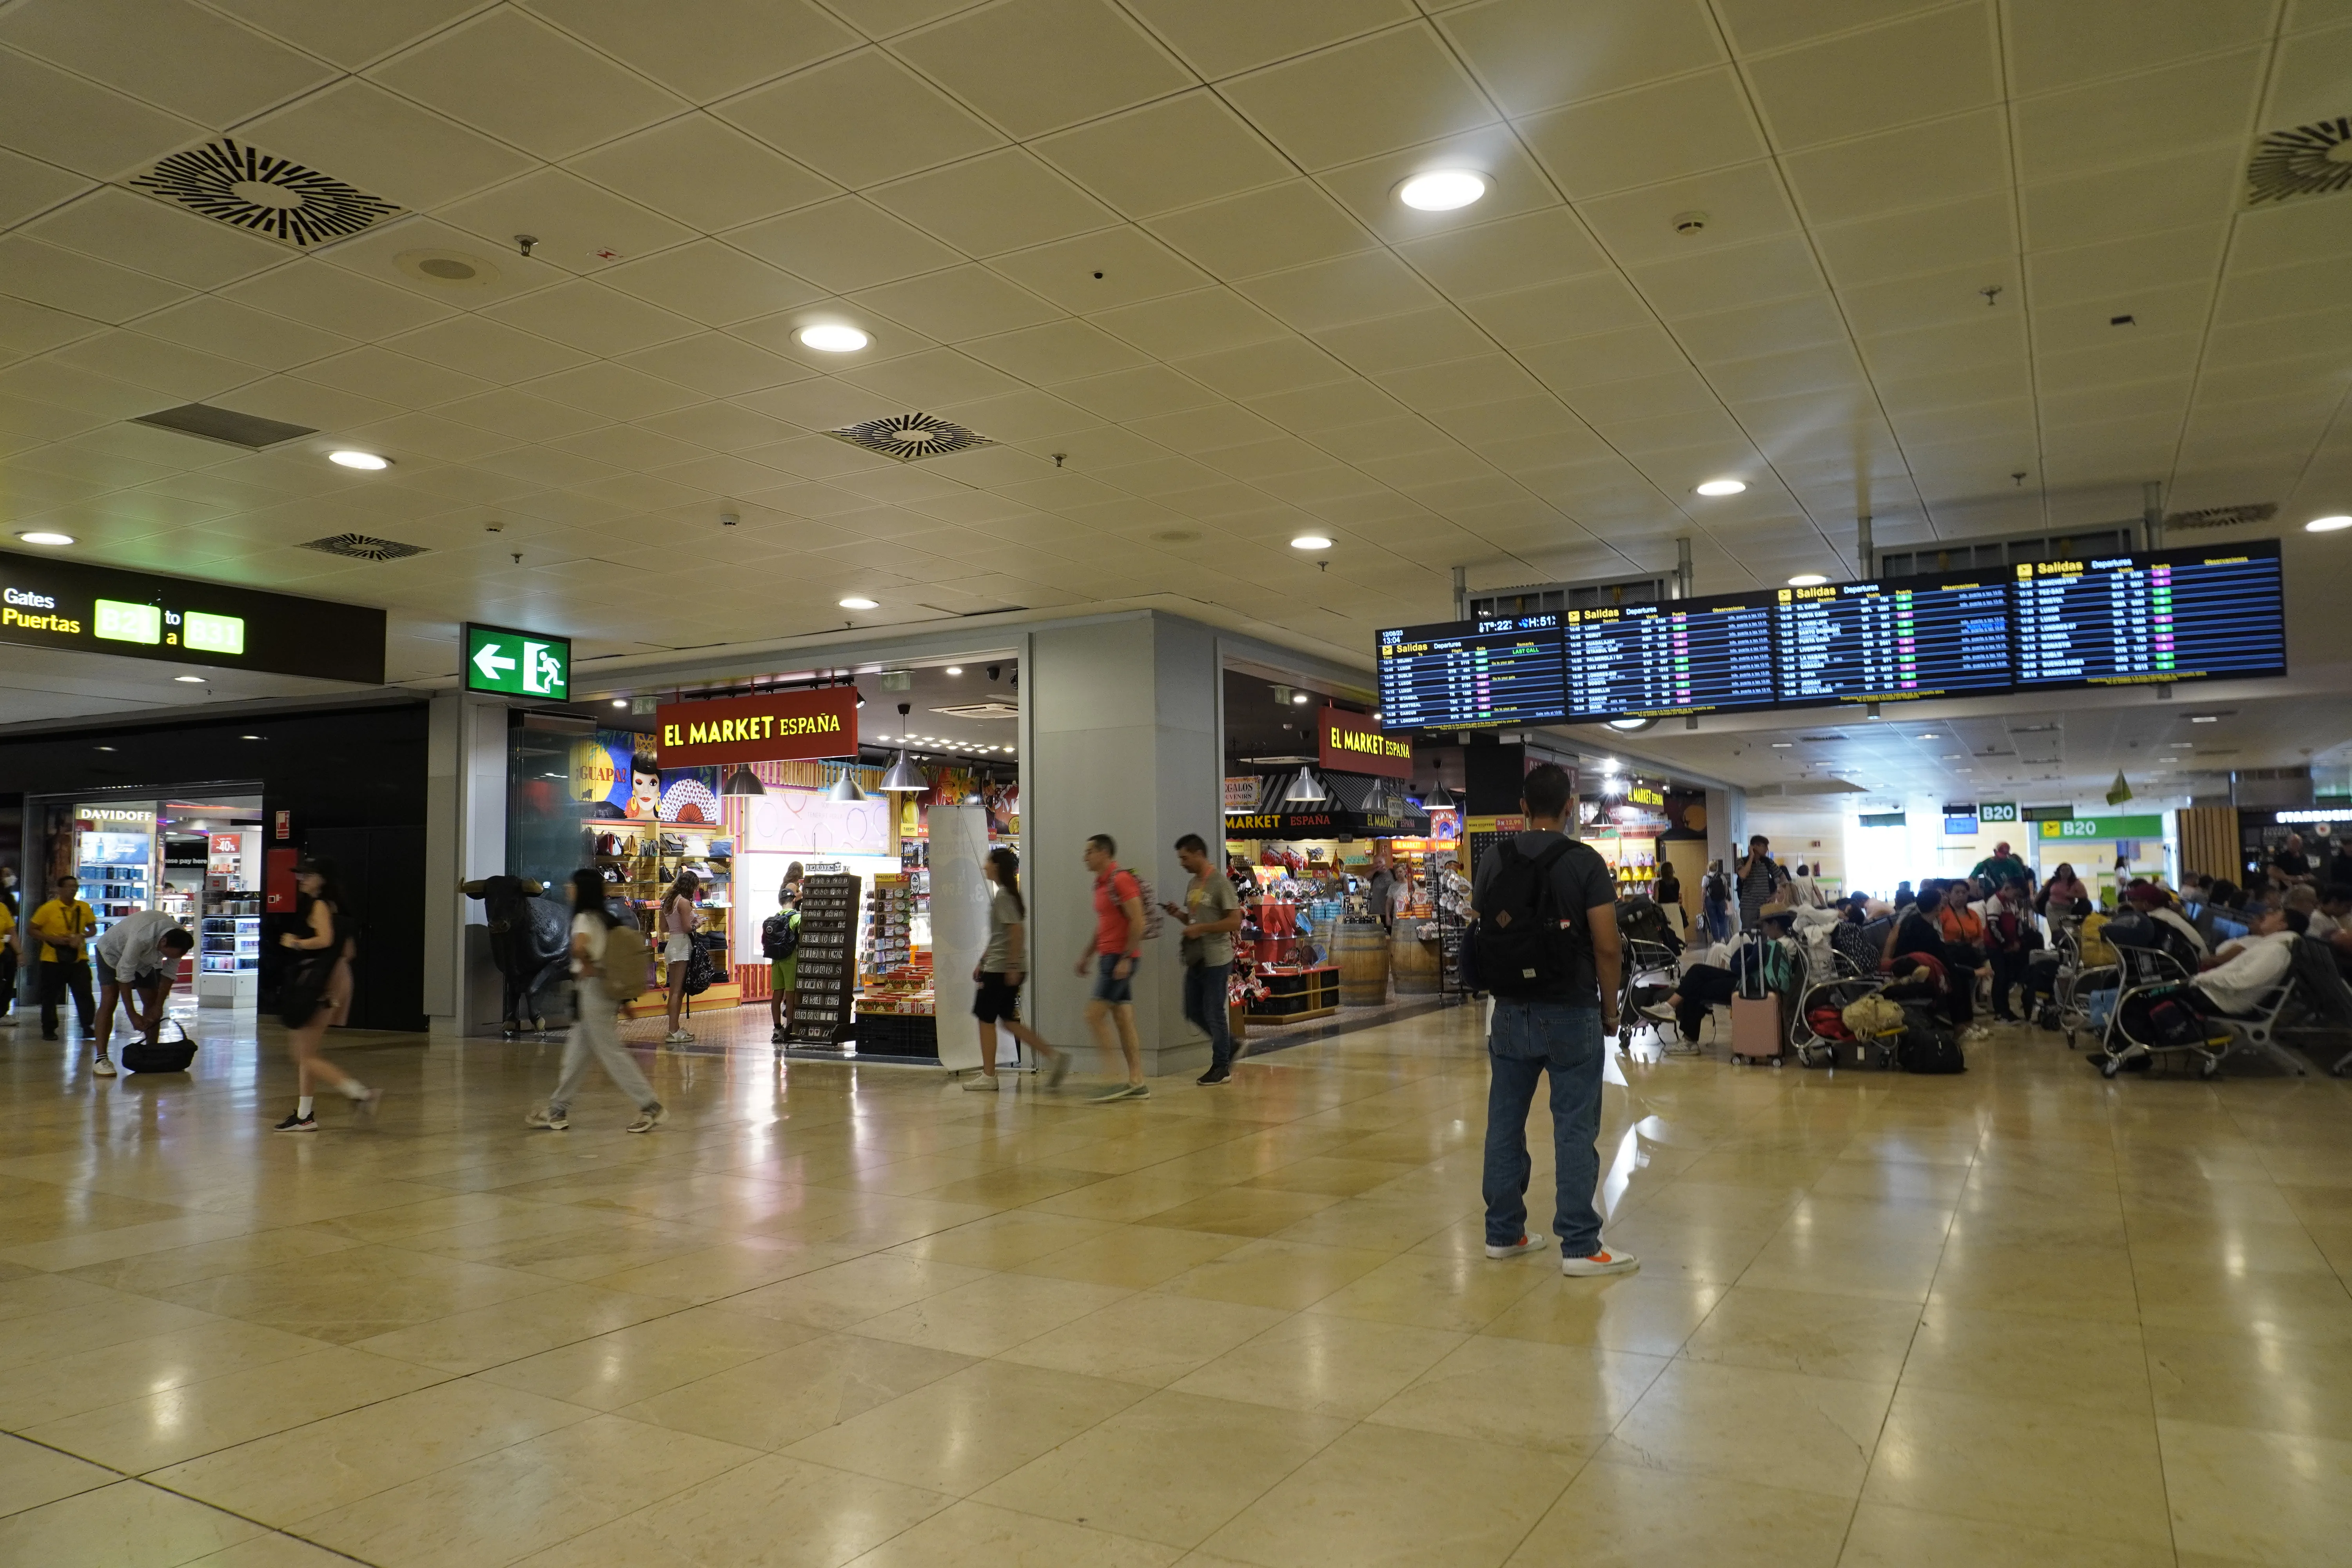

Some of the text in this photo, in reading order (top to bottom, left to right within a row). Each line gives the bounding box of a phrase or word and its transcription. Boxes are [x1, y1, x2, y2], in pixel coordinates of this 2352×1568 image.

[2038, 559, 2132, 574] Salidas Departures
[4, 588, 55, 608] Gates
[1797, 584, 1879, 599] Salidas Departures
[3, 608, 80, 633] Puertas
[165, 610, 181, 625] to
[1584, 607, 1657, 619] Salidas Departures
[166, 633, 177, 645] a
[190, 620, 237, 646] B31
[1383, 636, 1400, 644] 13:04
[1397, 641, 1461, 653] Salidas Departures
[665, 713, 840, 746] EL MARKET ESPAÑA
[1332, 727, 1410, 759] EL MARKET ESPAÑA
[576, 766, 626, 782] ¡GUAPA!
[1628, 786, 1663, 806] EL MARKET ESPAÑA
[81, 809, 152, 821] DAVIDOFF
[1982, 806, 2013, 820] B20
[2276, 809, 2352, 823] STARBUCK
[1225, 814, 1331, 829] MARKET ESPAÑA
[1367, 814, 1373, 826] EL
[1375, 815, 1397, 828] MARKET
[2063, 822, 2096, 835] B20
[216, 840, 235, 851] -40%
